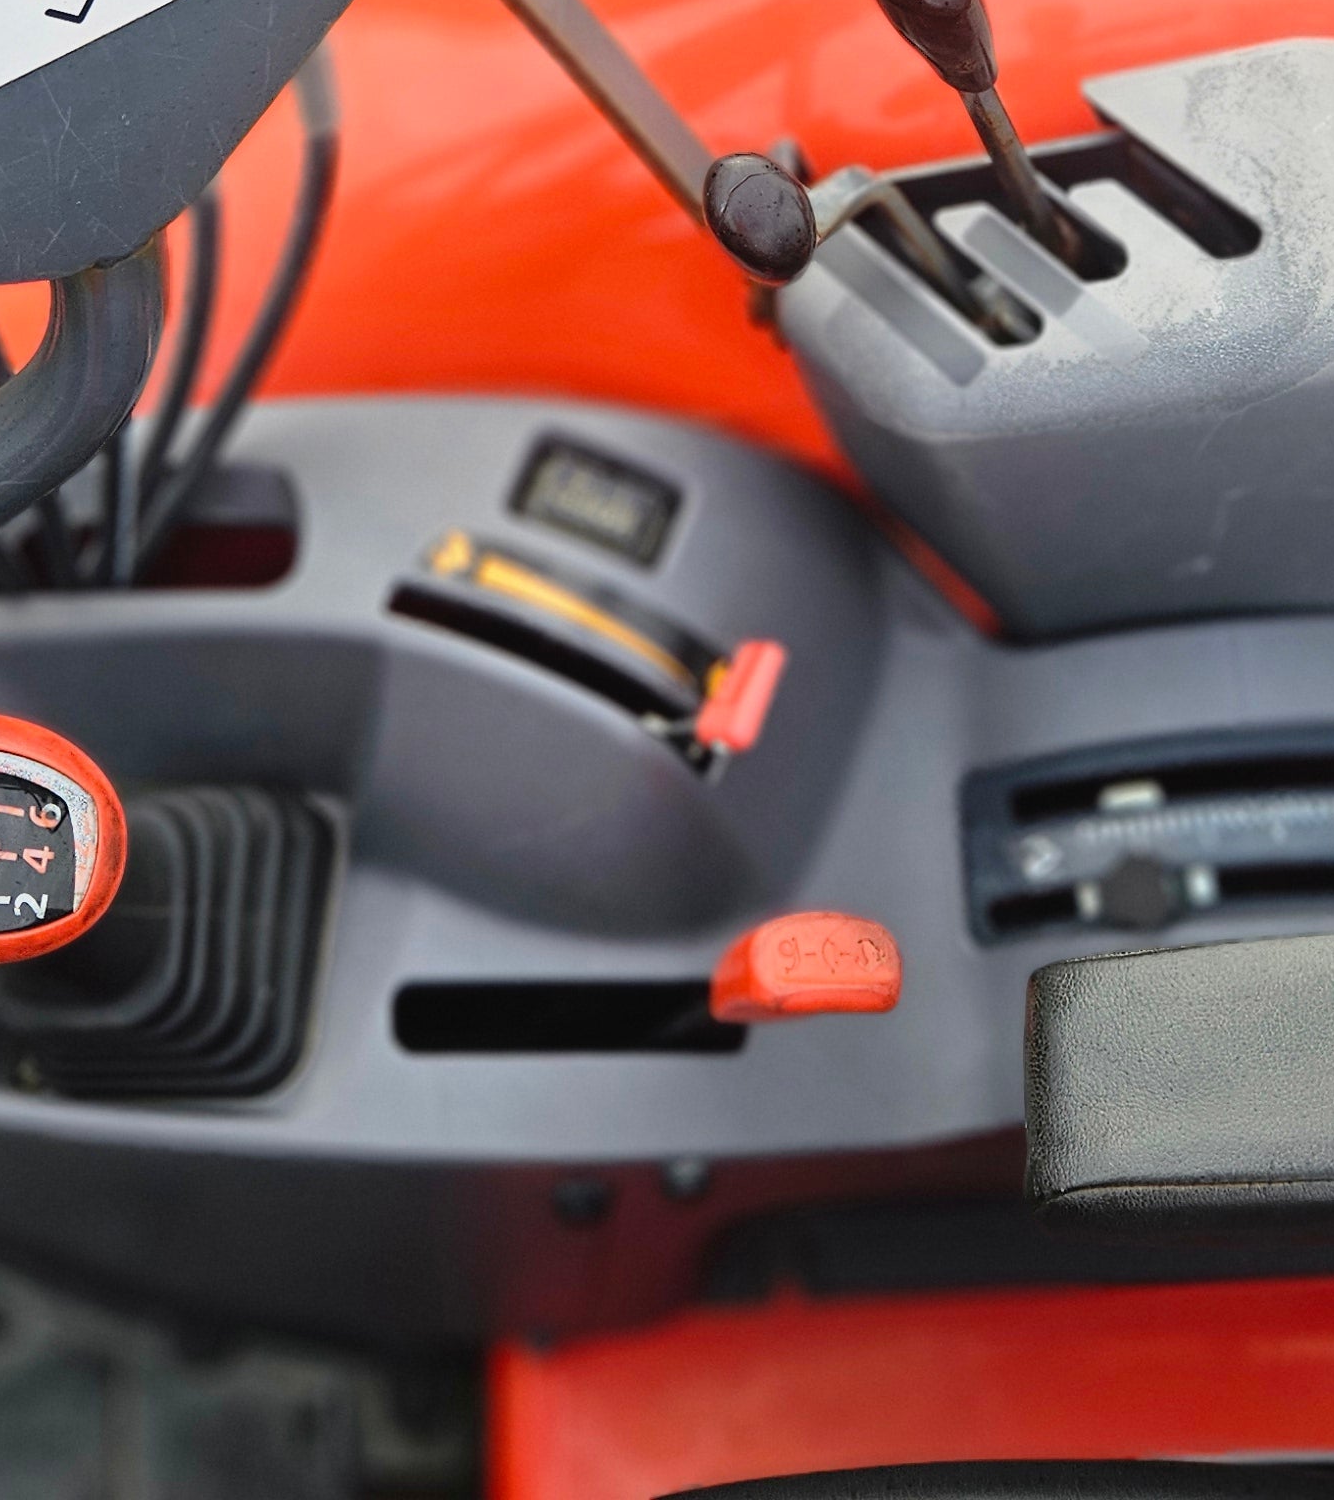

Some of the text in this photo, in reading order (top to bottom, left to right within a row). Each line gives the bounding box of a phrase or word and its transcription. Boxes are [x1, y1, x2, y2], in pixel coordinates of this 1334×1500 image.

[29, 802, 62, 828] 6
[22, 845, 55, 875] 4
[14, 892, 49, 920] 2
